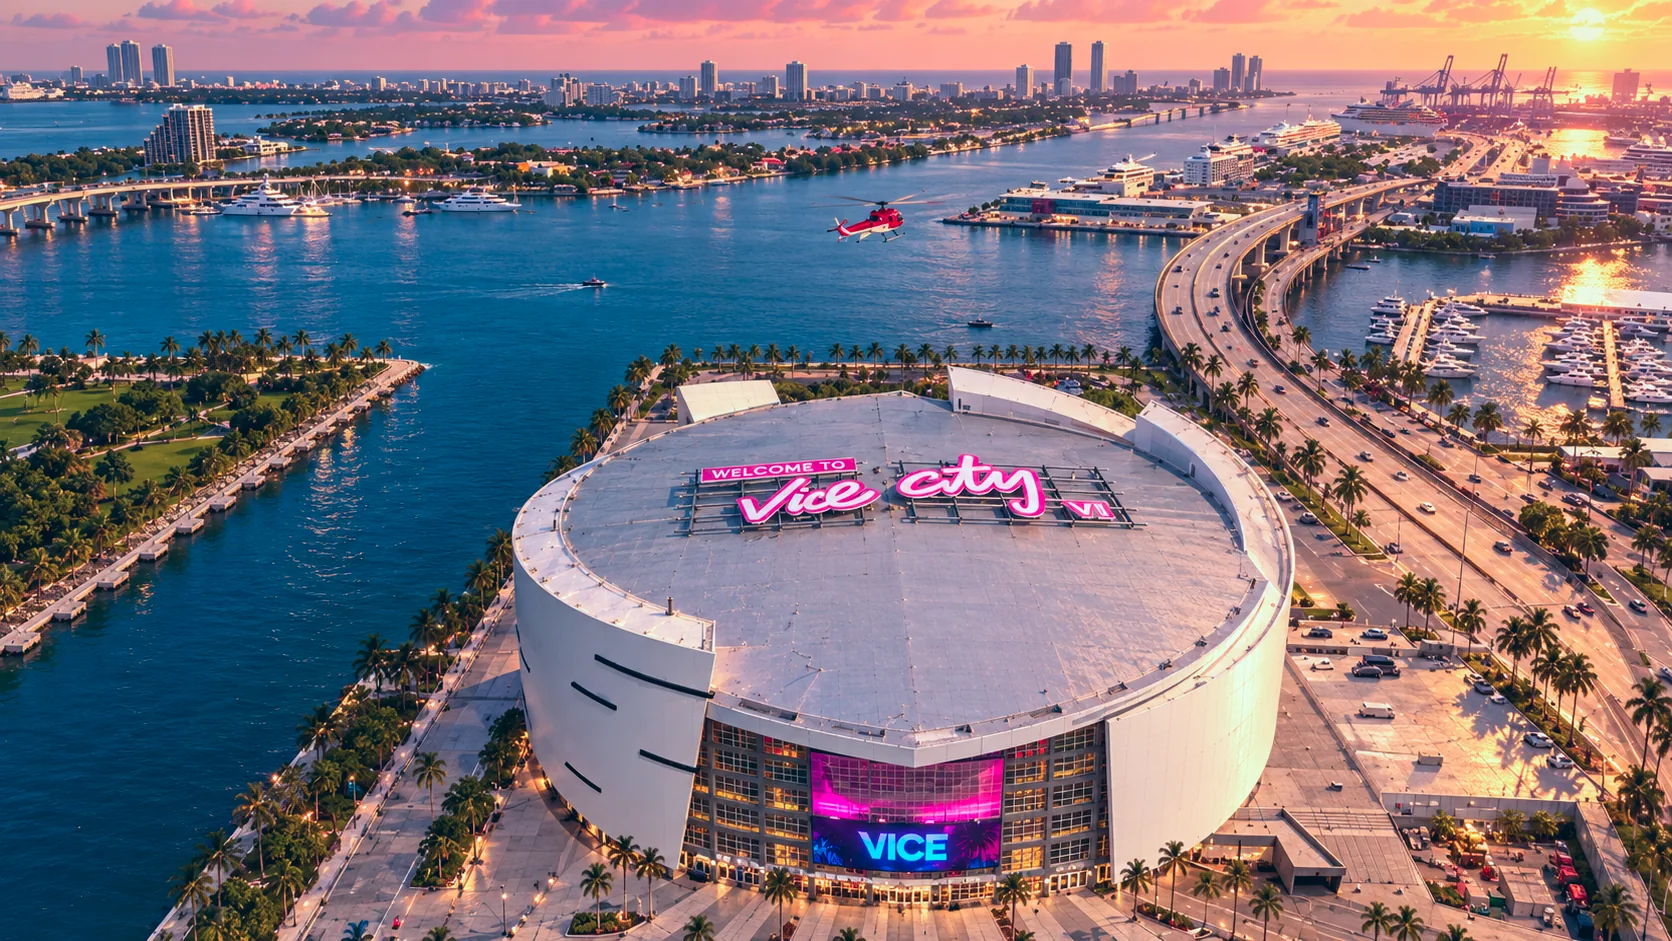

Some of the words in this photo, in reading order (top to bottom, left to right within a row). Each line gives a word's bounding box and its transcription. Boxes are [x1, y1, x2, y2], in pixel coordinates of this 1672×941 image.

[712, 462, 814, 479] WELCOME
[819, 460, 846, 471] TO
[739, 477, 878, 521] Vice
[898, 454, 1042, 514] city
[858, 831, 948, 861] VICE
